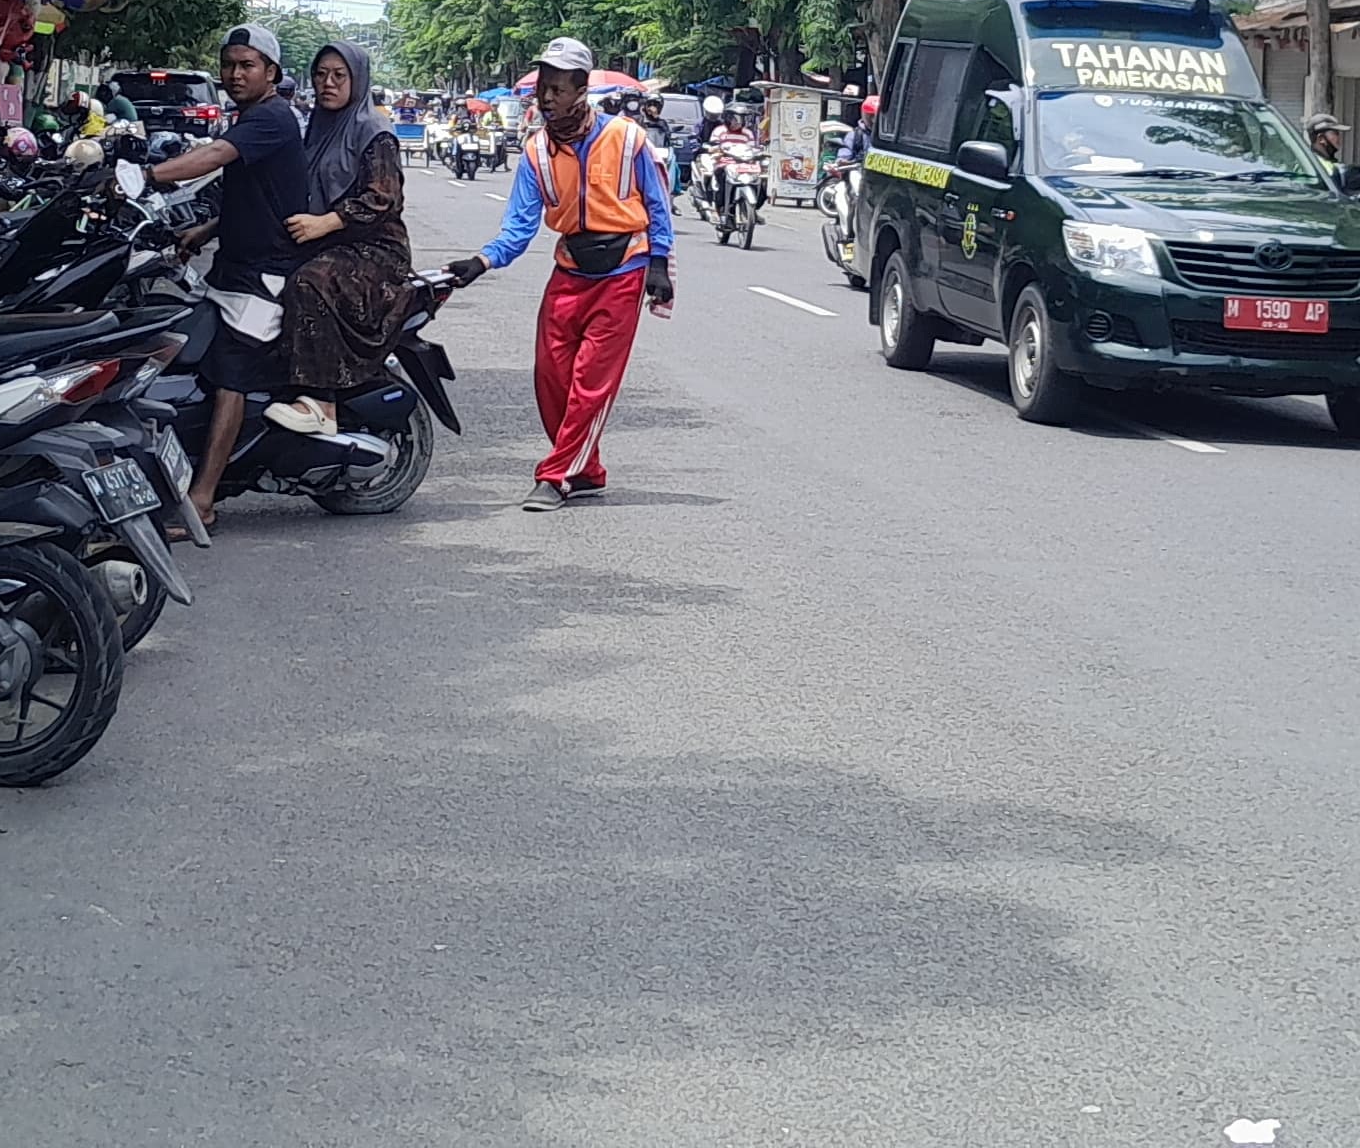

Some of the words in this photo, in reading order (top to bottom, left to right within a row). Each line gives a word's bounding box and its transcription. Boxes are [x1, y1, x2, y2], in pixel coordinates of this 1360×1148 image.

[1051, 43, 1226, 76] TAHANAN
[1077, 68, 1225, 94] PAMEKASAN
[1227, 299, 1240, 318] M
[1255, 300, 1291, 320] 1590
[1304, 303, 1325, 321] AP
